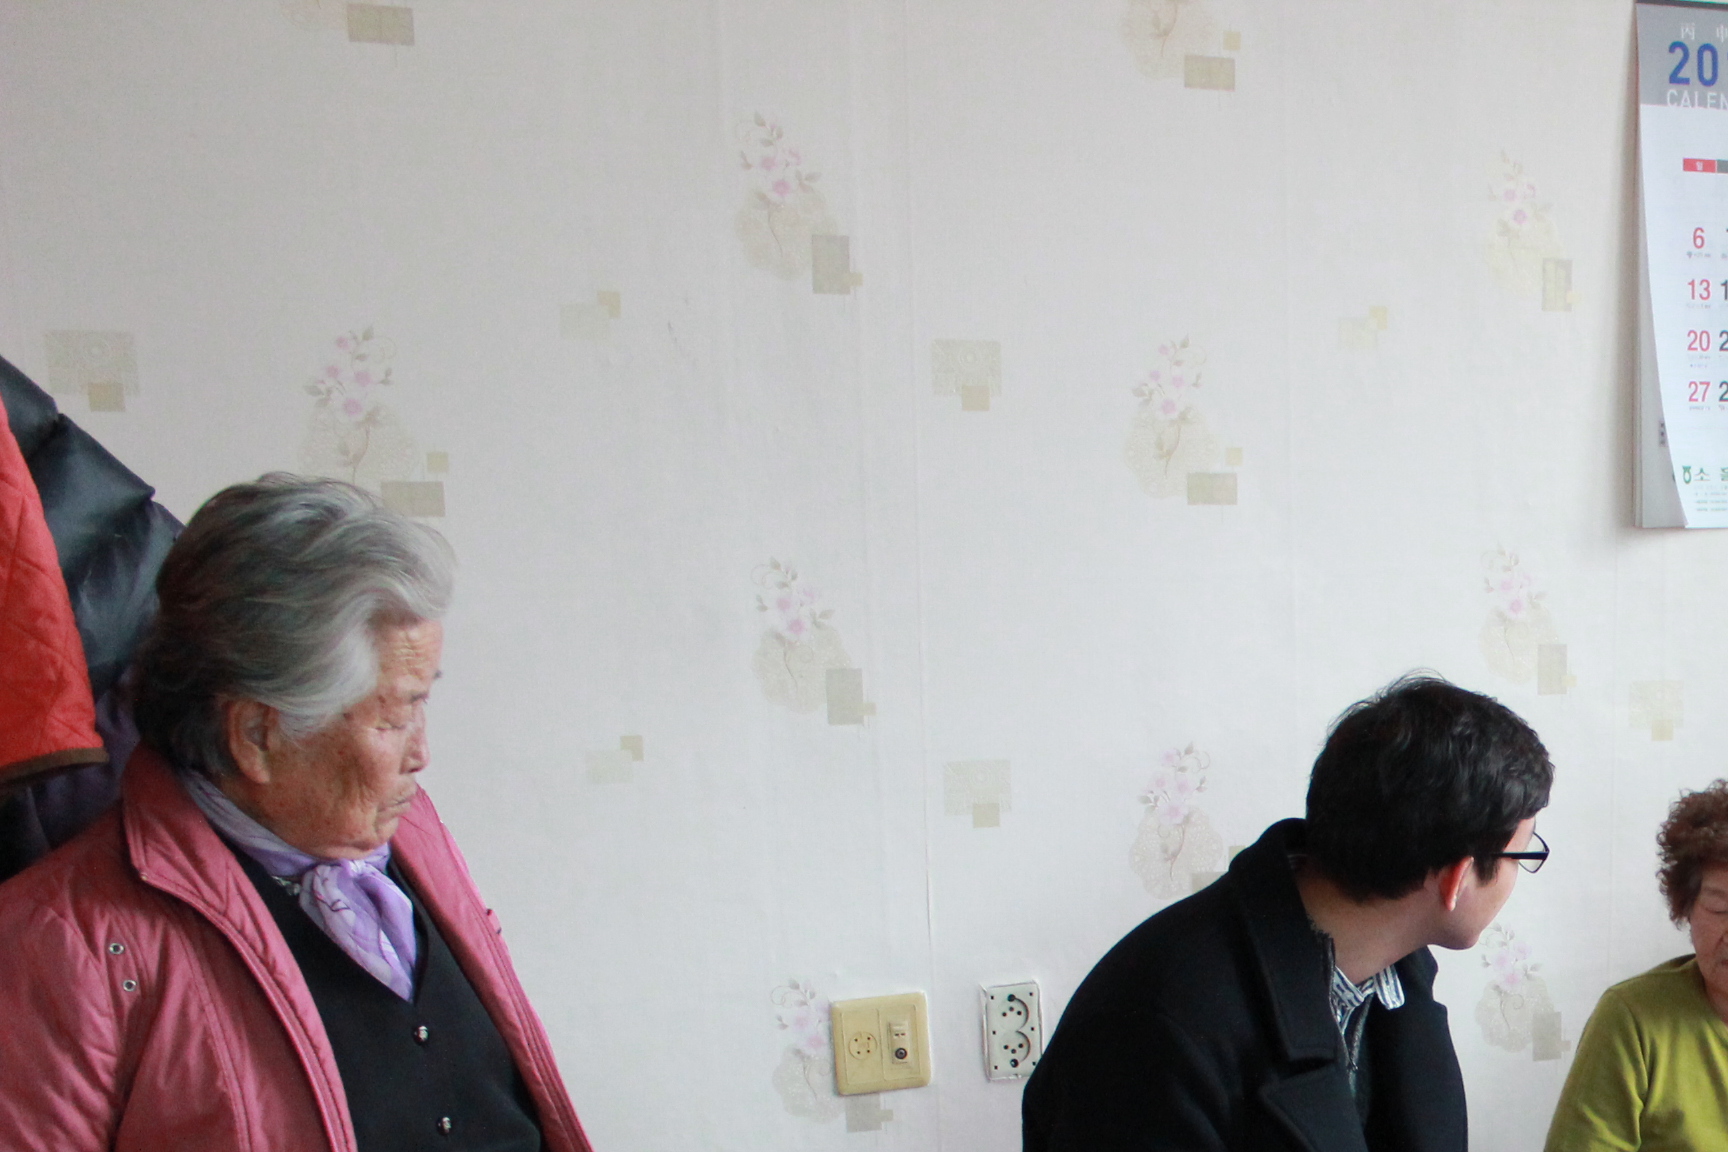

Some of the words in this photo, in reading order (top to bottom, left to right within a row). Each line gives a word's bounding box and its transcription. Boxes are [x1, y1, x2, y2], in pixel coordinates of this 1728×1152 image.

[1693, 227, 1705, 249] 6
[1687, 278, 1711, 301] 13
[1687, 329, 1711, 352] 20
[1688, 381, 1711, 402] 27
